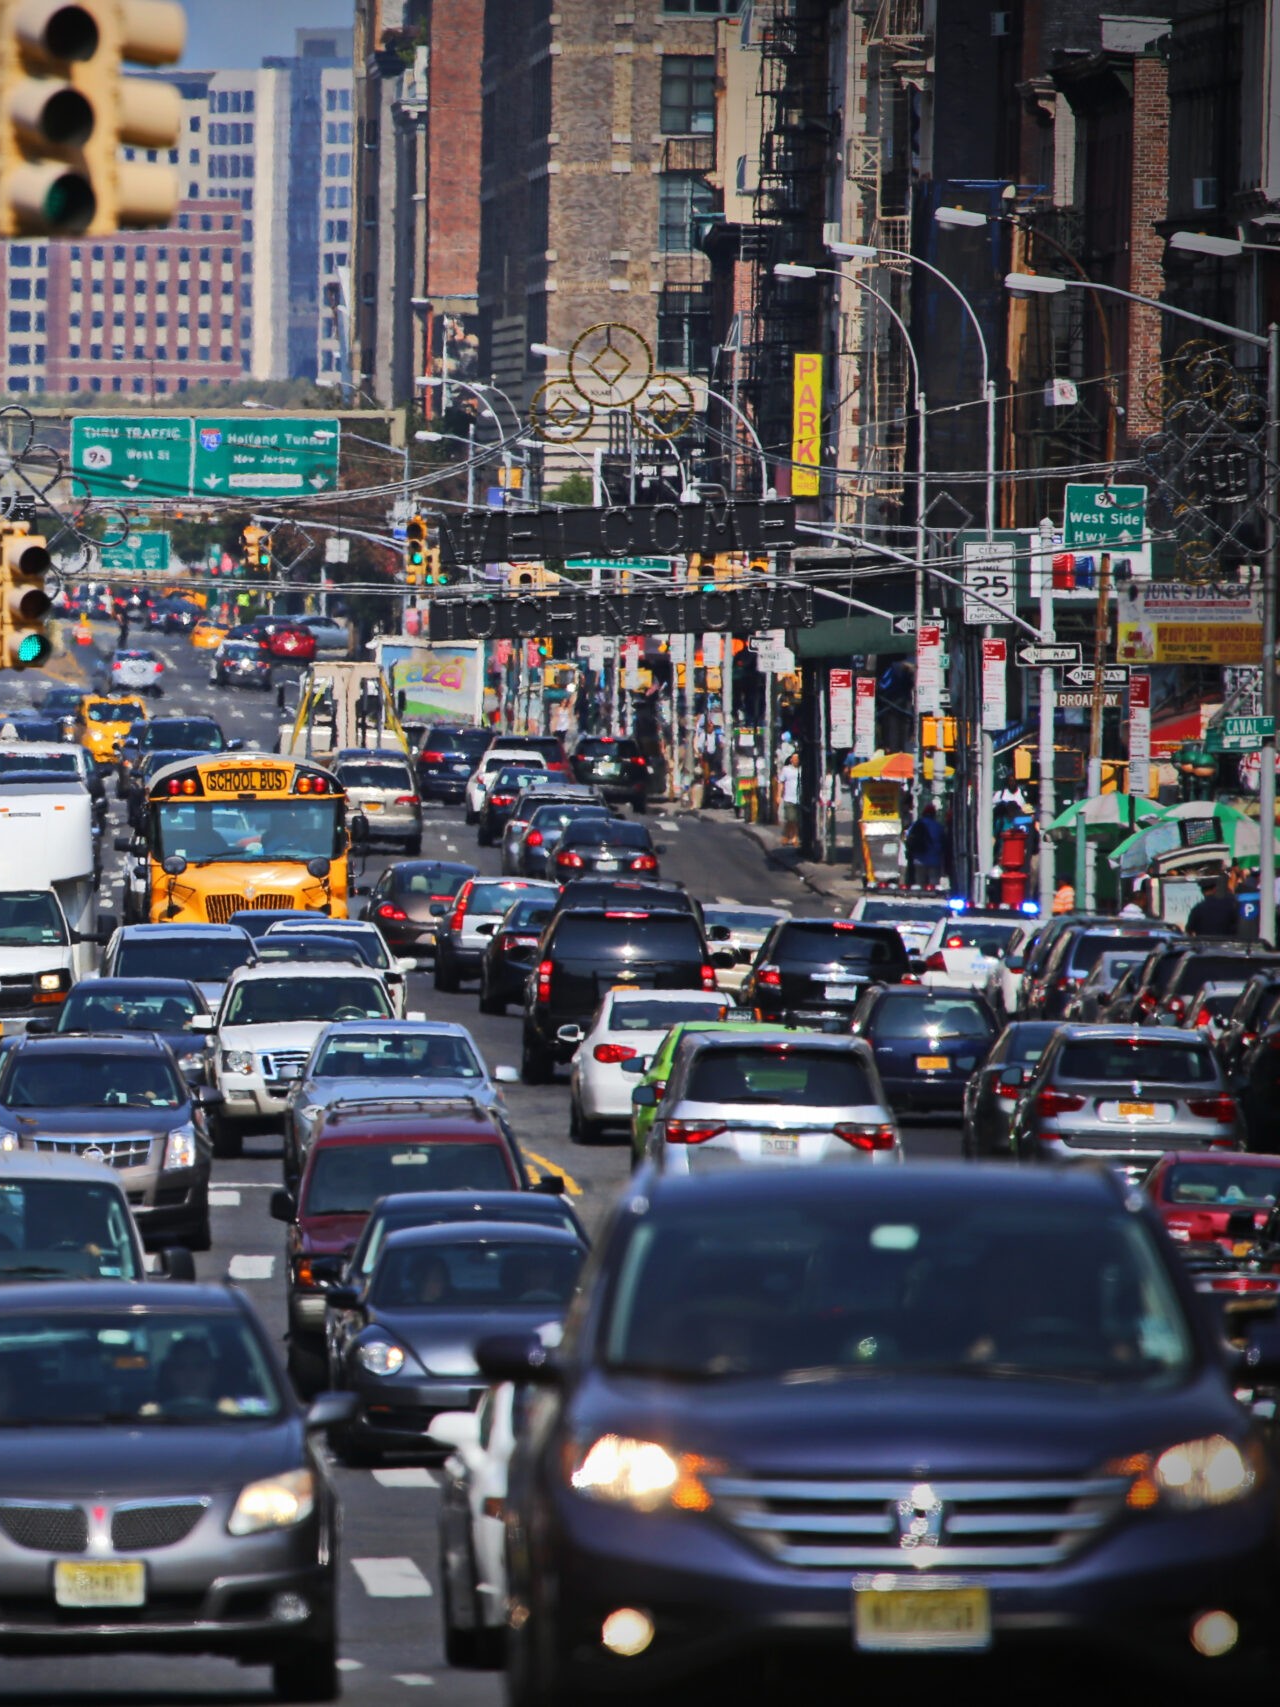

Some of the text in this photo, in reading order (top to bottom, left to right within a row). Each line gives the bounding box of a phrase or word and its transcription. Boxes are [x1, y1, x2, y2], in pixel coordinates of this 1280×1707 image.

[796, 357, 818, 463] PARK
[82, 426, 181, 439] THRU TRAFFIC
[89, 452, 106, 463] 9A
[1070, 511, 1141, 526] West Side
[441, 498, 796, 563] WELCOME
[1074, 530, 1108, 546] Hwy
[972, 575, 1009, 598] 25
[510, 585, 814, 638] CHINATOWN
[1073, 671, 1093, 680] ONE
[1060, 693, 1119, 707] BROAAY
[1226, 718, 1273, 735] CANAL ST
[208, 771, 283, 790] SCHOOL BUS
[1244, 903, 1255, 917] P
